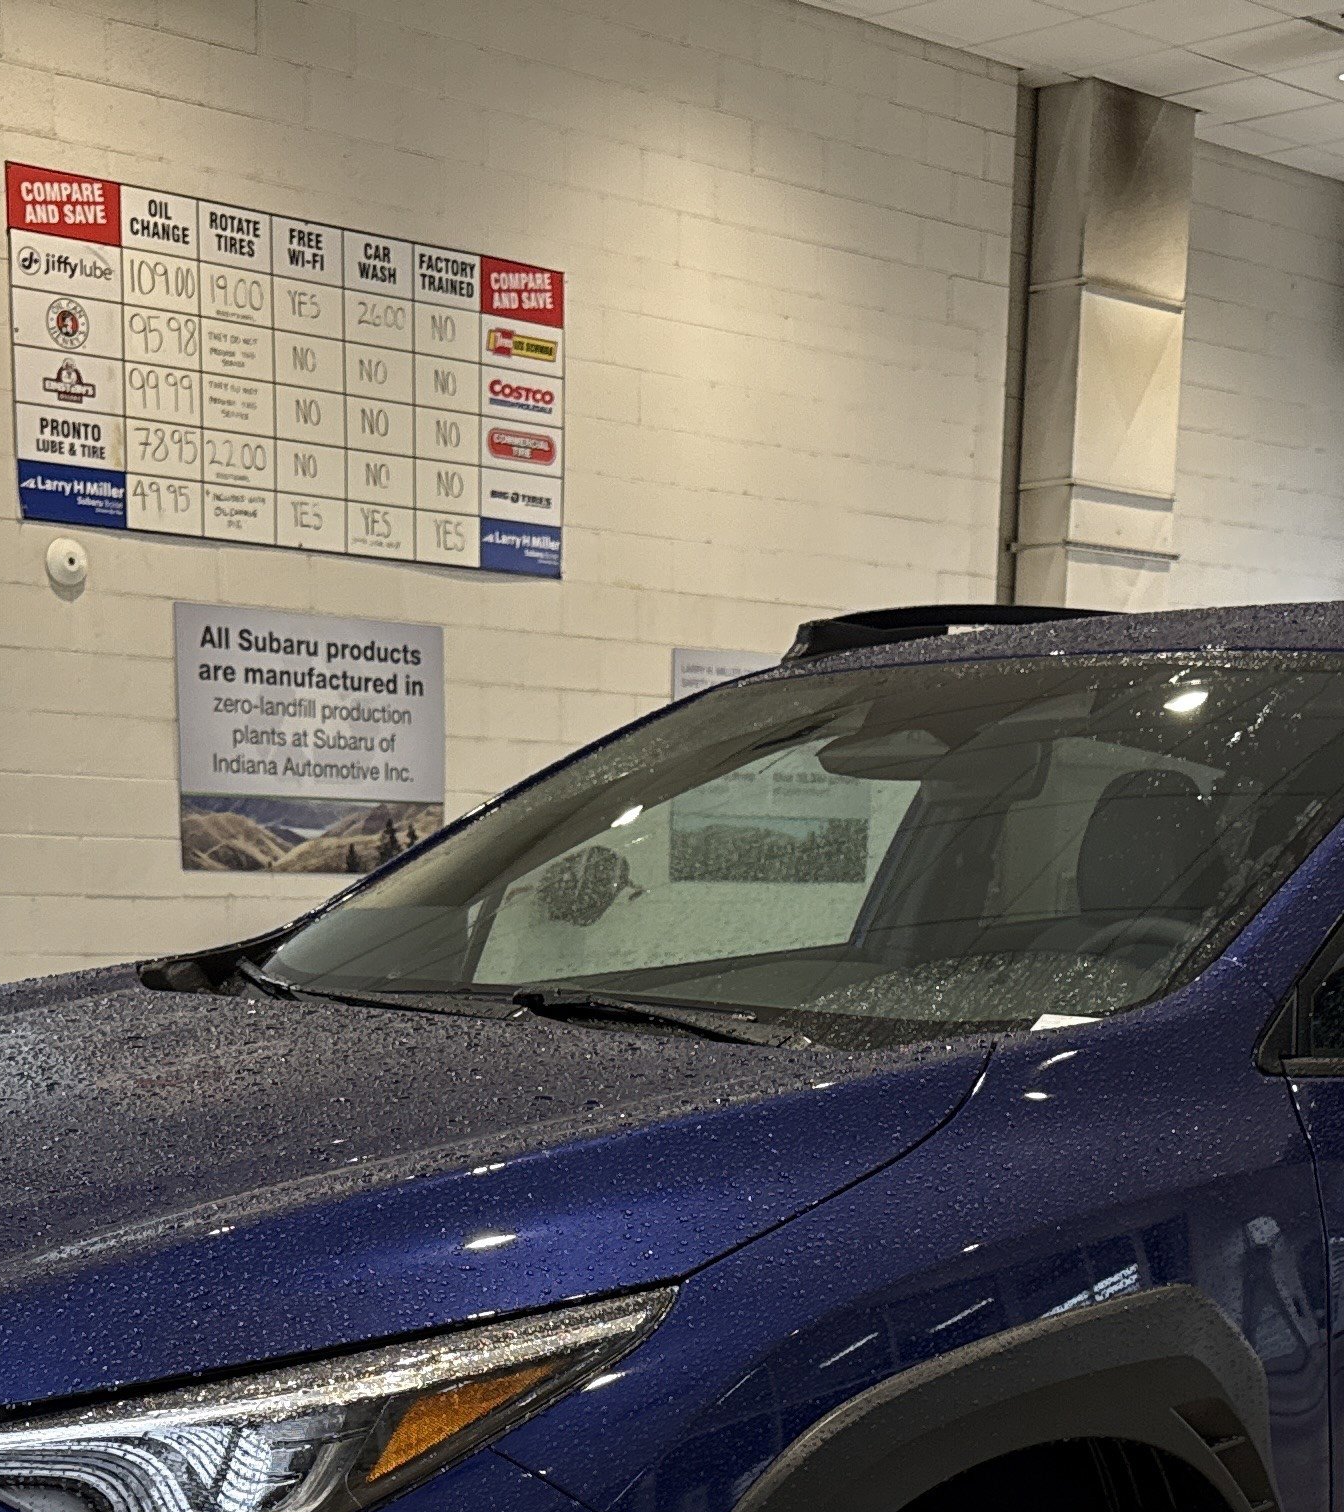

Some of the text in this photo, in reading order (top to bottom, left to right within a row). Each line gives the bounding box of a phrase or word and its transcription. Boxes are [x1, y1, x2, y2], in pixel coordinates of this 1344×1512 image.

[20, 181, 105, 203] COMPARE
[24, 204, 107, 225] AND SAVE
[148, 199, 172, 220] OIL
[129, 217, 191, 245] CHANGE
[209, 211, 261, 239] ROTATE
[215, 233, 256, 258] TIRES
[288, 228, 323, 250] FREE
[287, 248, 325, 272] WI-FI
[363, 242, 391, 264] CAR
[419, 253, 476, 280] FACTORY
[129, 258, 196, 299] 109.00
[358, 261, 397, 285] WASH
[420, 274, 475, 299] TRAINED
[490, 272, 553, 290] COMPARE
[287, 289, 322, 320] YES
[492, 291, 554, 310] AND SAVE
[431, 314, 456, 343] NO
[292, 346, 317, 373] NO
[359, 358, 388, 385] NO
[434, 369, 456, 397] NO
[489, 379, 555, 406] COSTCO
[295, 398, 322, 427] NO
[360, 407, 390, 438] NO
[39, 417, 101, 442] PRONTO
[435, 419, 461, 448] NO
[36, 438, 106, 460] LUBE & TIRE
[293, 452, 318, 479] NO
[365, 462, 391, 489] NO
[37, 476, 125, 499] Larry H Miller
[436, 470, 464, 499] NO
[290, 500, 324, 531] YES
[360, 507, 392, 539] YES
[433, 518, 467, 552] YES
[495, 531, 522, 549] Larry
[200, 625, 422, 667] All Subaru products
[199, 663, 425, 697] are manufactured in
[213, 696, 413, 726] zero-landfill production
[232, 725, 396, 753] plants at Subaru of
[212, 753, 415, 783] Indiana Automotive Inc.
